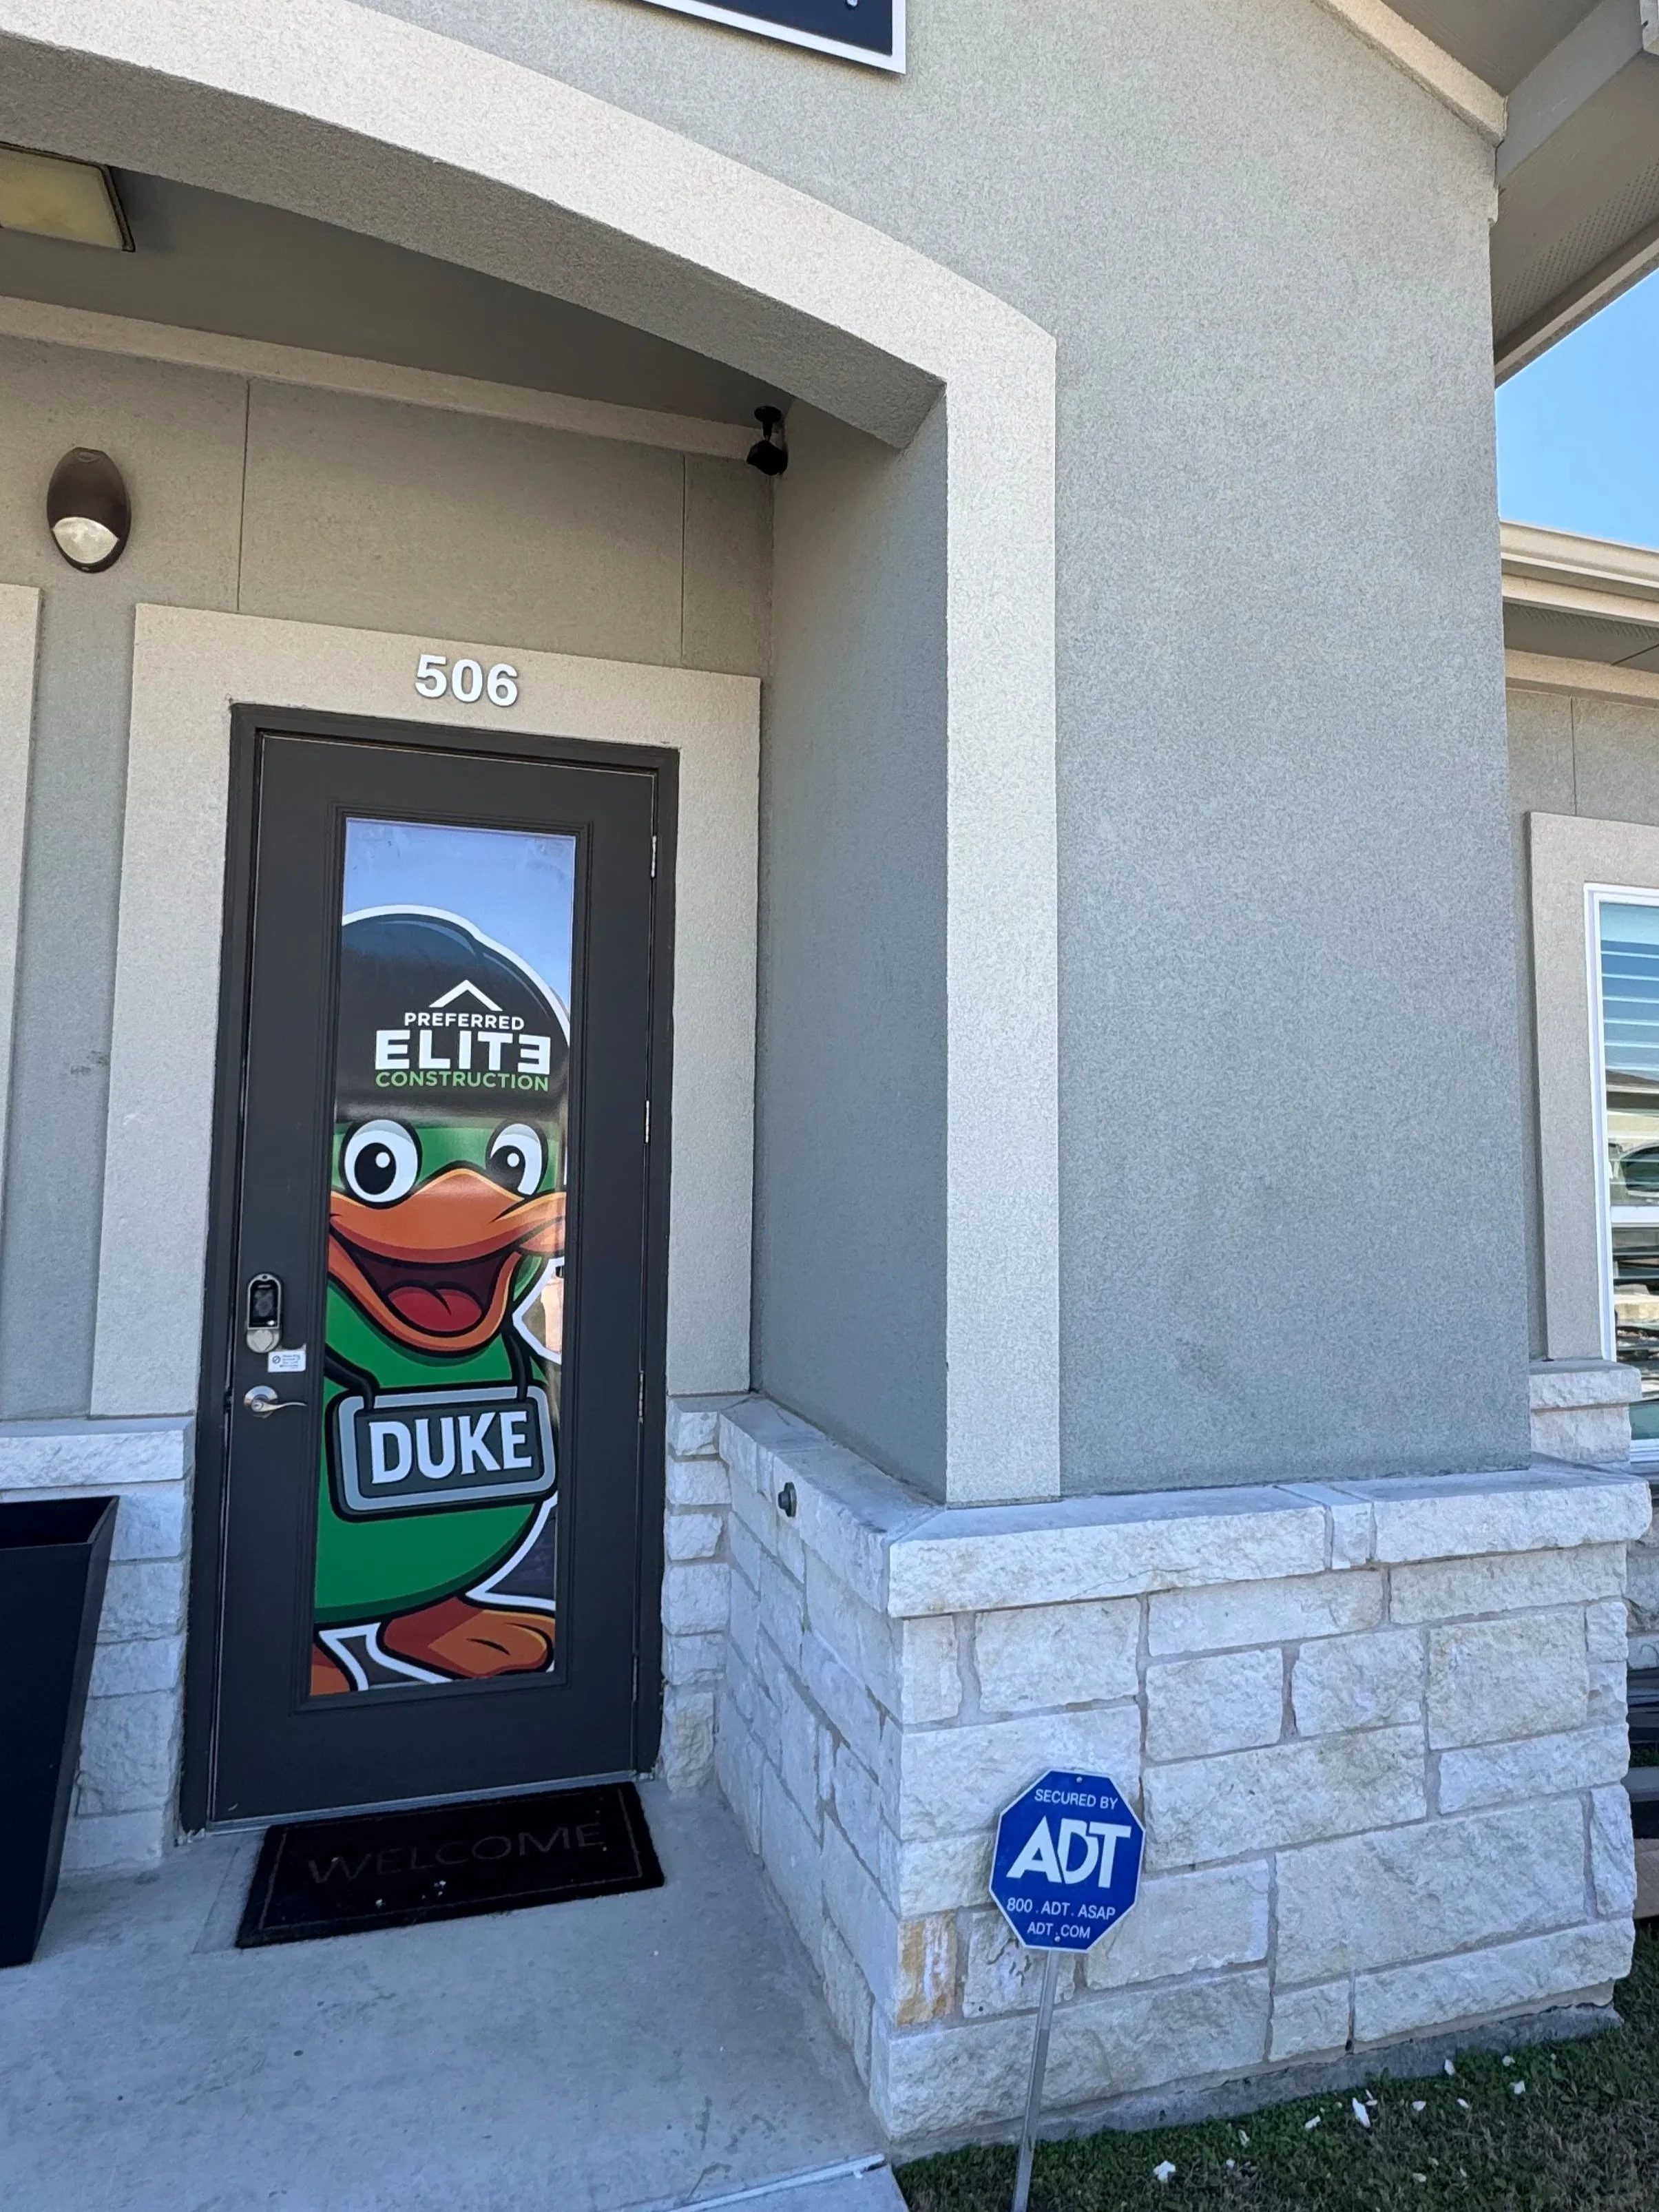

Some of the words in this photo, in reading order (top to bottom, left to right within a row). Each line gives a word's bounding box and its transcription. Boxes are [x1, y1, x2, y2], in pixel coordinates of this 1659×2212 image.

[415, 654, 519, 707] 506
[404, 1012, 525, 1031] PREFERRED
[375, 1070, 549, 1092] CONSTRUCTION
[368, 1410, 532, 1485] DUKE
[1034, 1788, 1096, 1808] SECURED
[1099, 1795, 1118, 1810] BY
[307, 1822, 605, 1884] WELCOME
[1005, 1815, 1131, 1889] ADT
